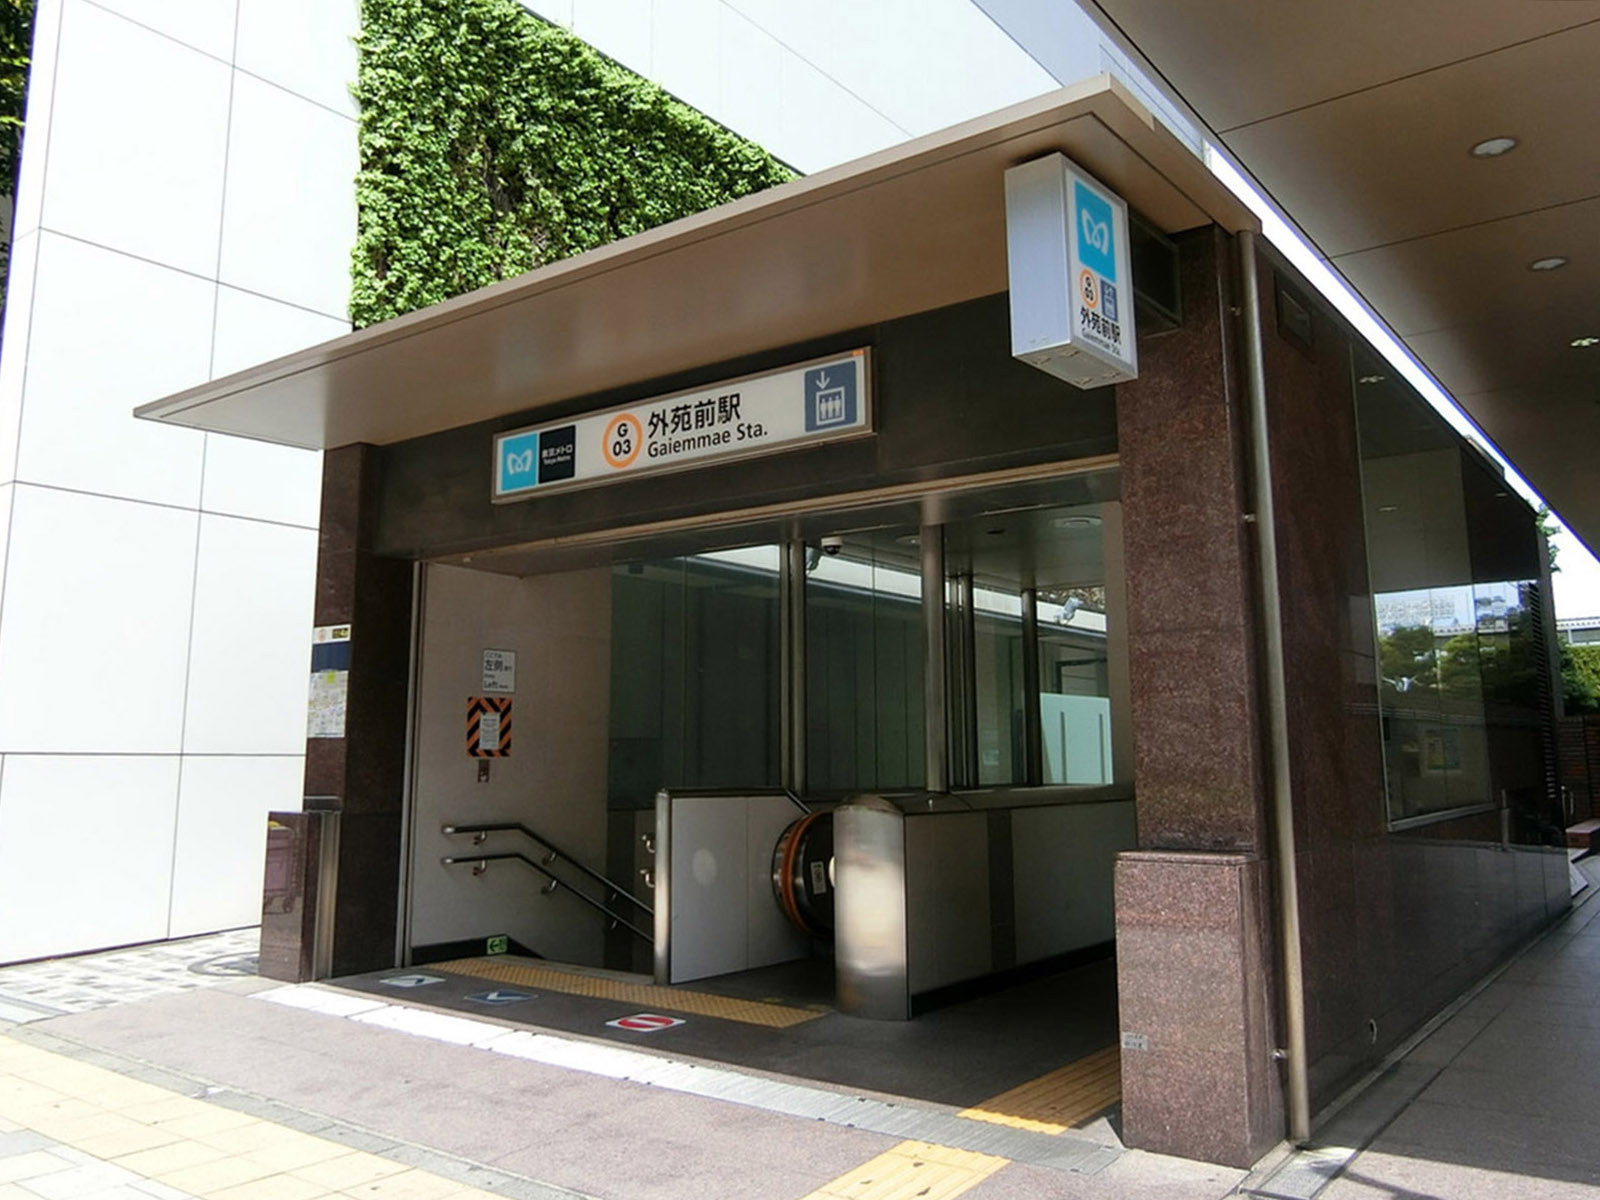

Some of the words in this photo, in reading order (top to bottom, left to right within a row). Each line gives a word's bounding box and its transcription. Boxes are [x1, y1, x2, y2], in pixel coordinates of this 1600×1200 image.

[1080, 305, 1122, 344] 外苑前駅
[647, 392, 742, 438] 外苑前駅
[616, 422, 629, 438] G
[647, 428, 731, 458] Gaiemmae
[737, 420, 768, 441] Sta.
[542, 443, 574, 458] 東京メトロ
[612, 439, 632, 457] 03
